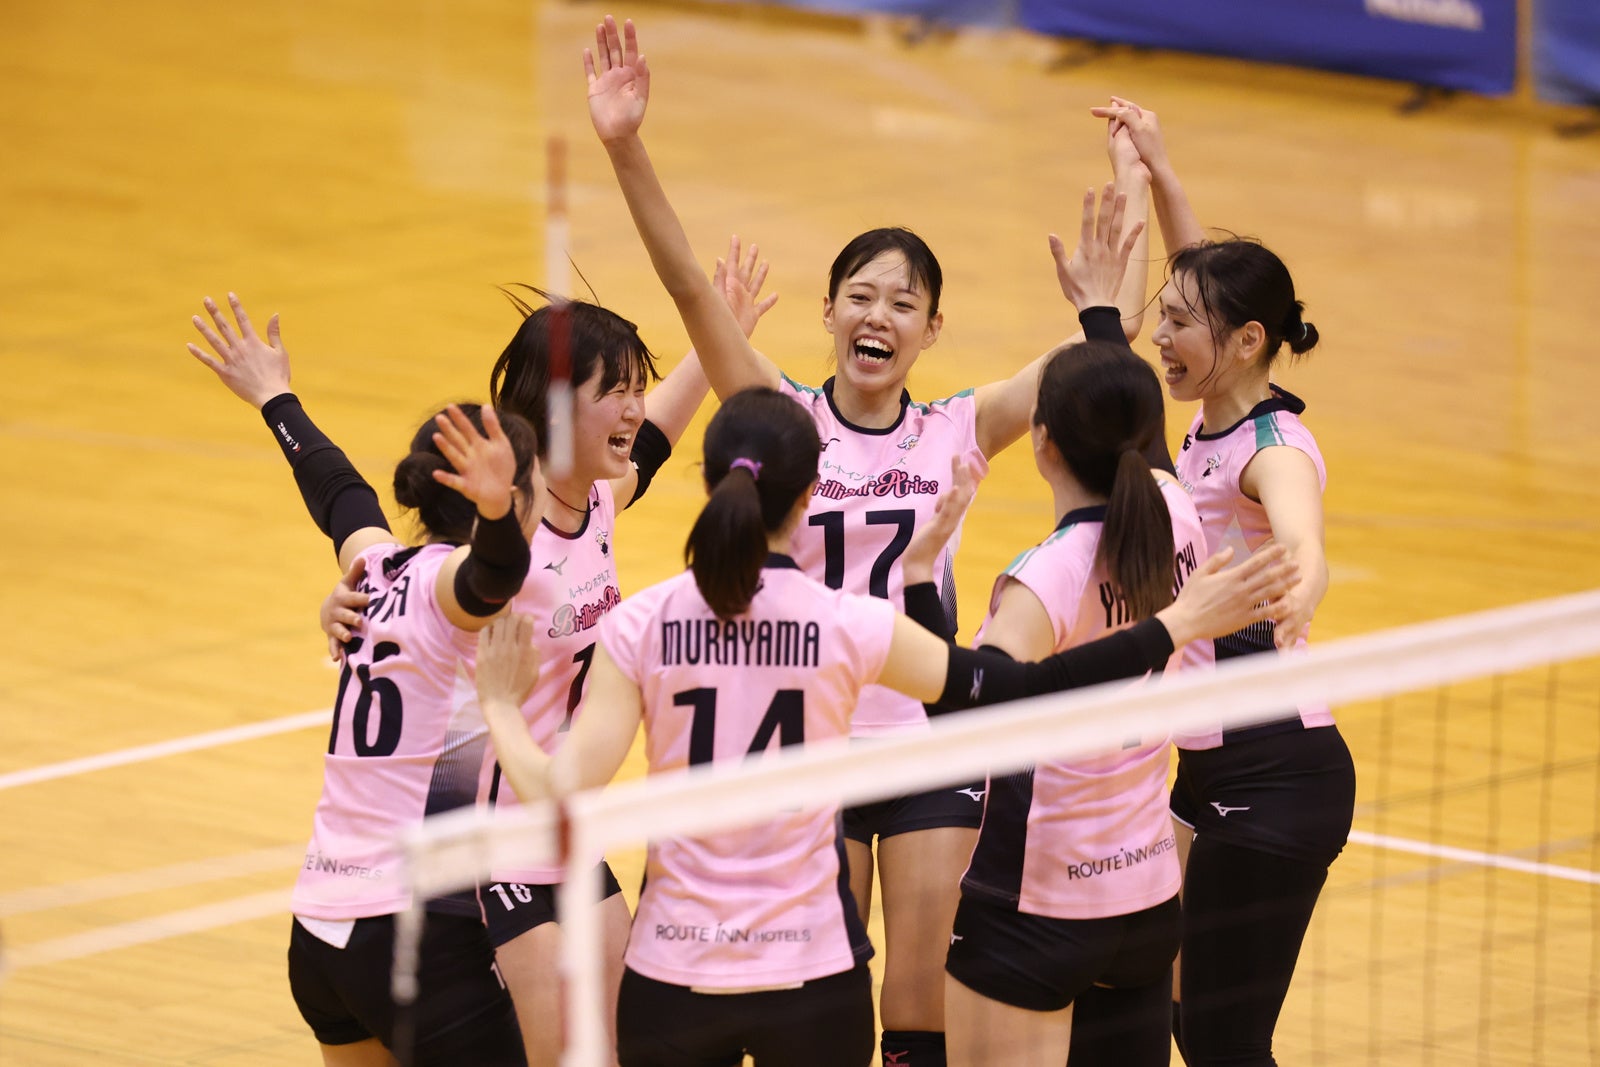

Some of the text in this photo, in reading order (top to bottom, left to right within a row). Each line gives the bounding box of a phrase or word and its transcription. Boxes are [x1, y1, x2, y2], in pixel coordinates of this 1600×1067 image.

[873, 468, 939, 499] Aries
[808, 509, 916, 600] 17
[662, 619, 820, 667] MURAYAMA
[673, 687, 805, 777] 14
[1067, 855, 1122, 880] ROUTE
[656, 924, 710, 942] ROUTE
[753, 929, 812, 943] HOTELS
